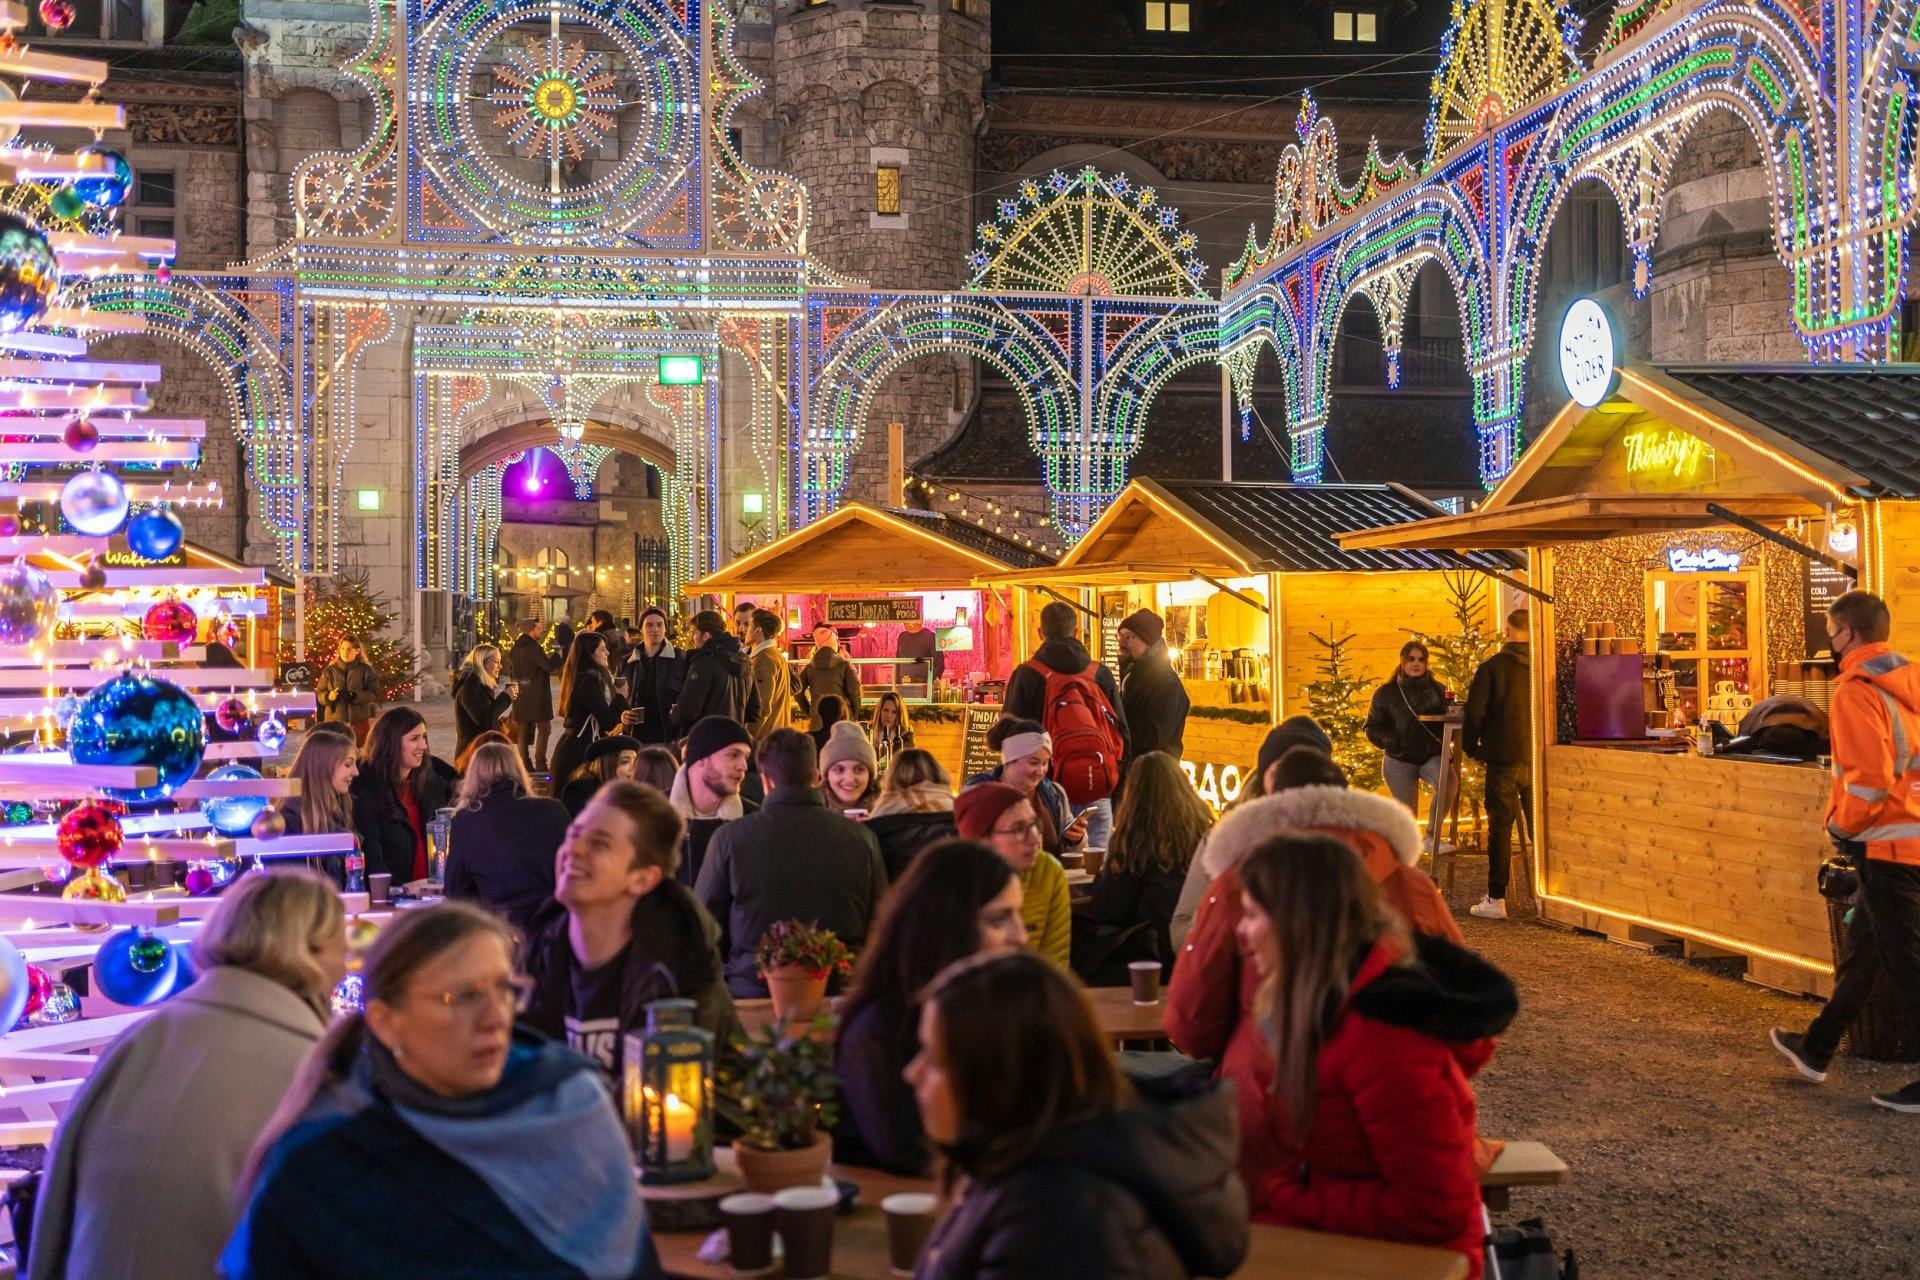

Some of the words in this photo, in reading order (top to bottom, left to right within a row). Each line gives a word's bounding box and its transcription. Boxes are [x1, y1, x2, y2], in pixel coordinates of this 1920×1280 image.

[1811, 587, 1827, 595] COLD
[829, 602, 857, 619] FRESH
[858, 602, 890, 620] INDIAN
[896, 609, 917, 619] FOOD
